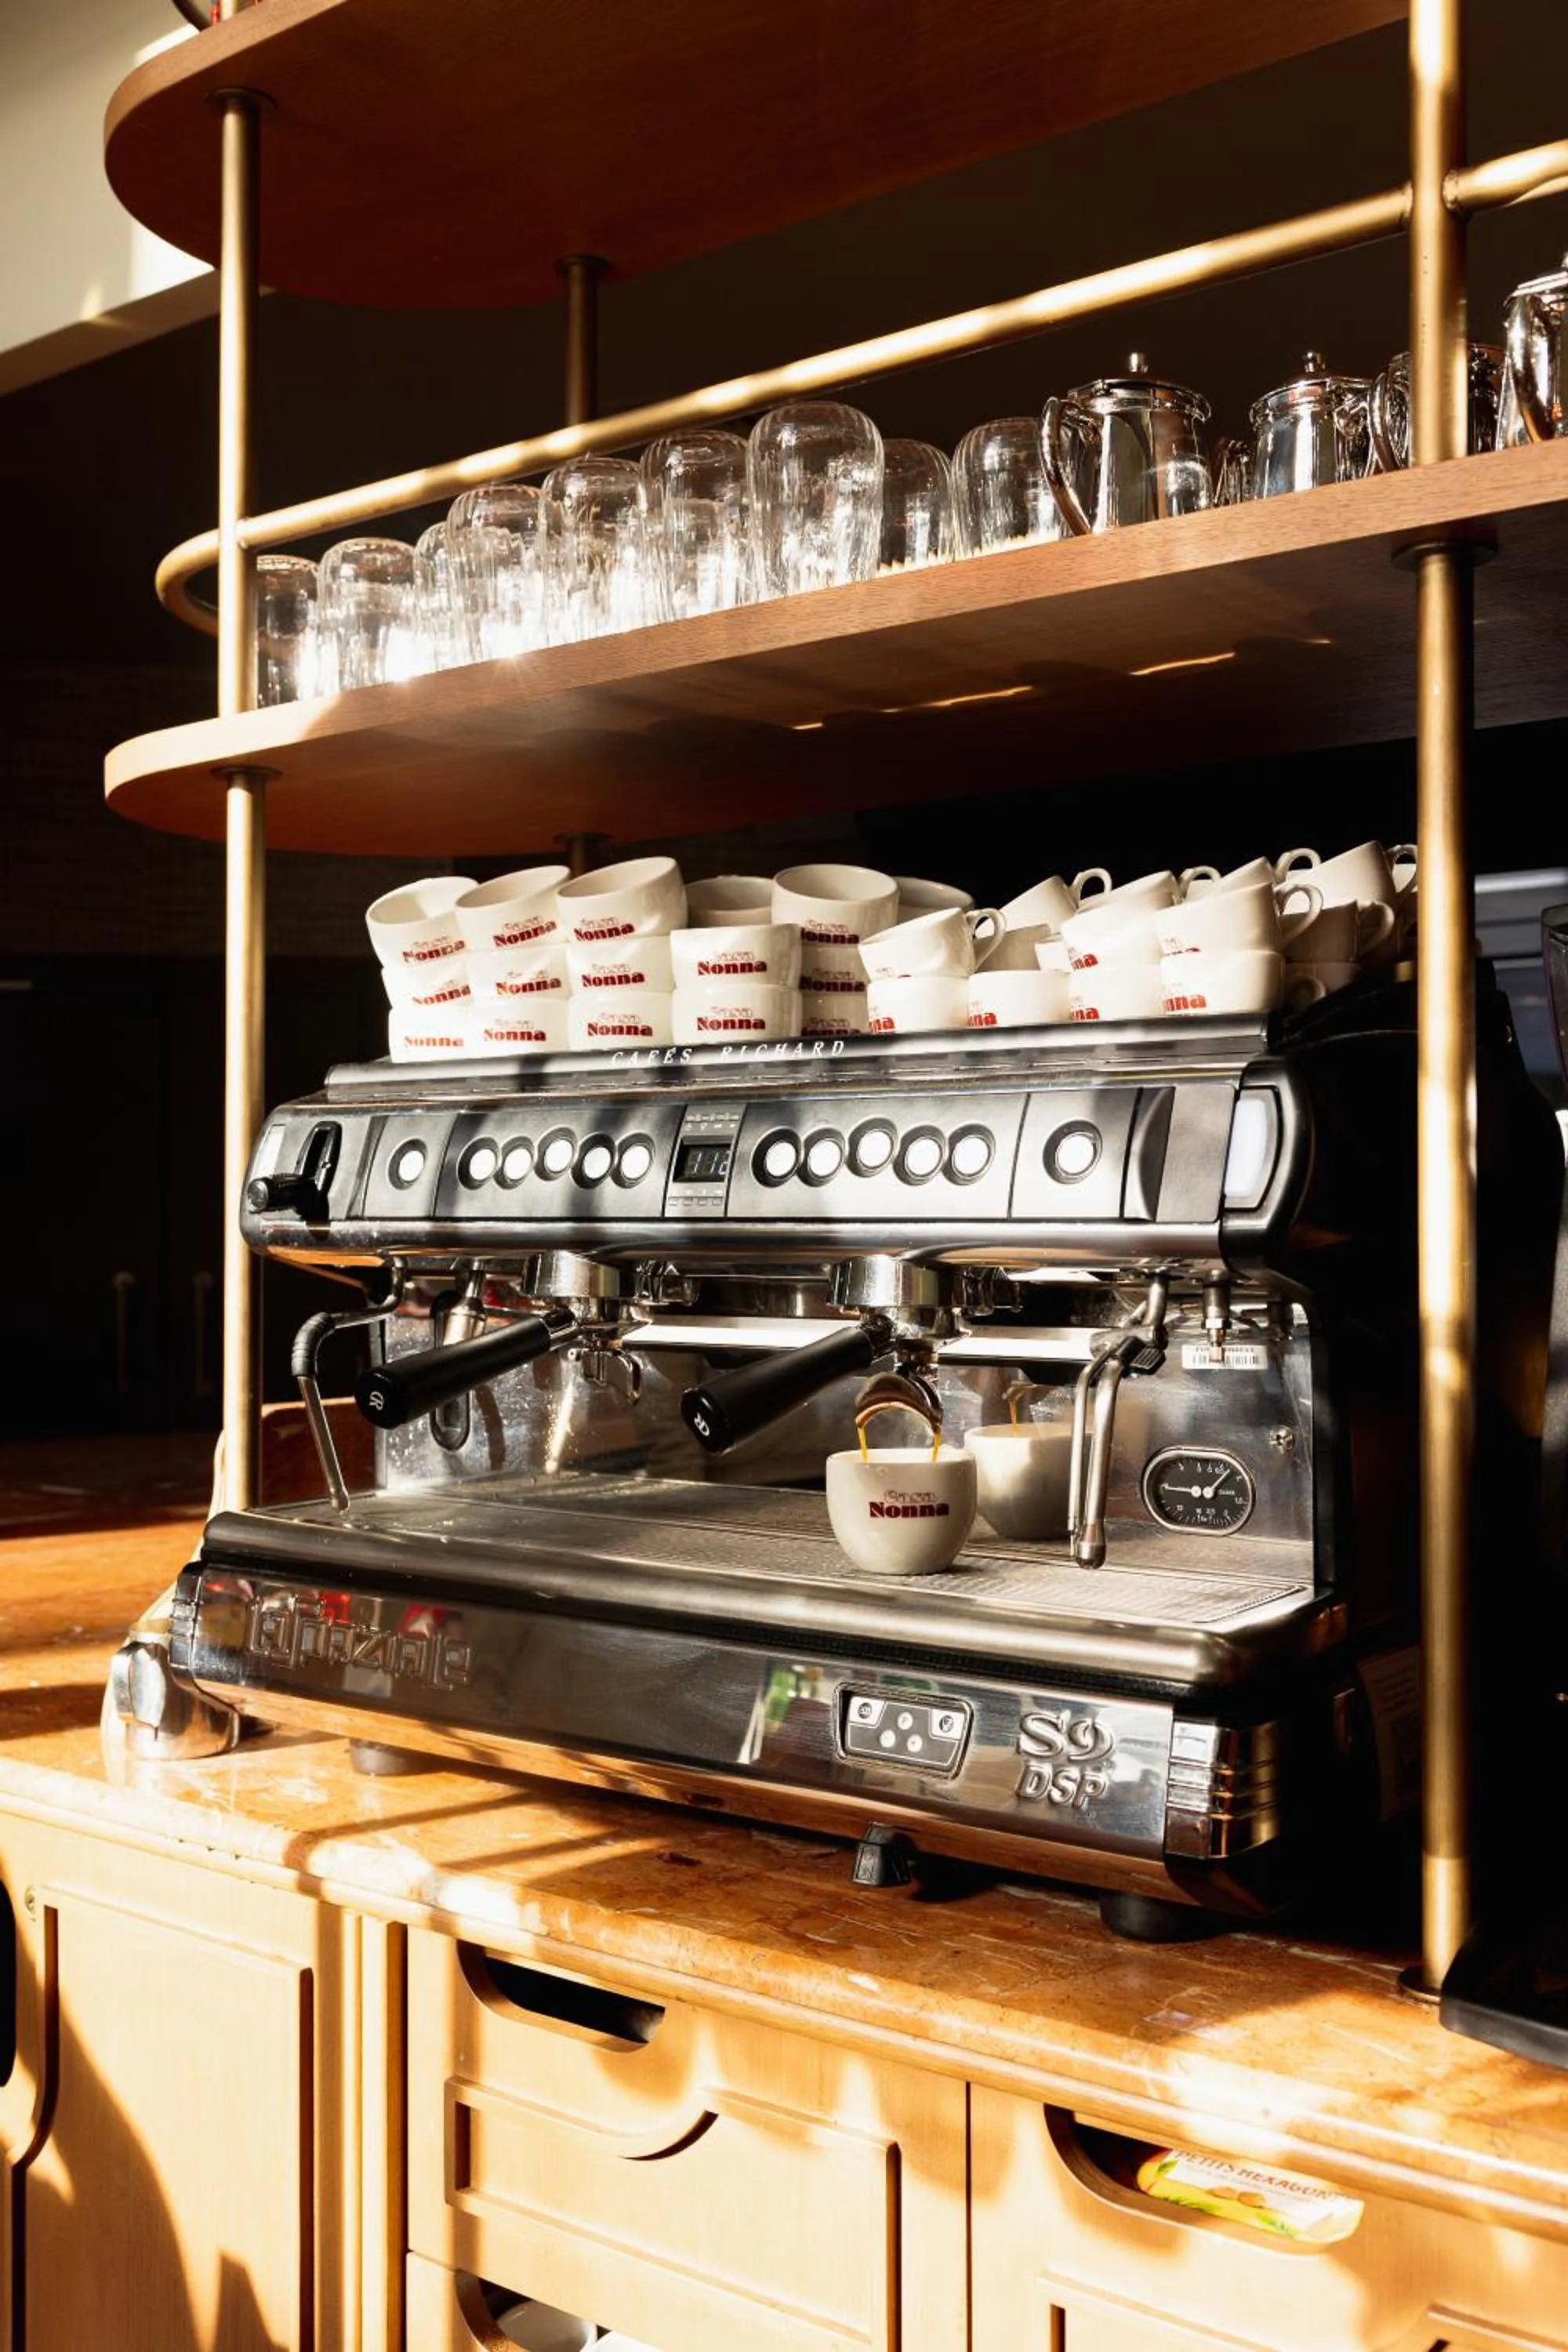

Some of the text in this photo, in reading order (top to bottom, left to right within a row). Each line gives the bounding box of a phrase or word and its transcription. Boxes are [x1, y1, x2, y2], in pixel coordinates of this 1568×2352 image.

[493, 921, 557, 947] Nonna
[574, 924, 635, 942] Nonna
[402, 940, 465, 963] Nonna
[698, 961, 768, 975] Nonna
[495, 978, 561, 995] Nonna
[582, 971, 645, 987] Nonna
[587, 1022, 653, 1036] Nonna
[697, 1017, 766, 1030] Nonna
[404, 1036, 464, 1047] Nonna
[484, 1029, 546, 1041] Nonna
[612, 1040, 844, 1065] CAFÉS RICHARD
[869, 1501, 949, 1519] Nonna
[1019, 1711, 1115, 1762] S9
[1017, 1764, 1110, 1810] DSP
